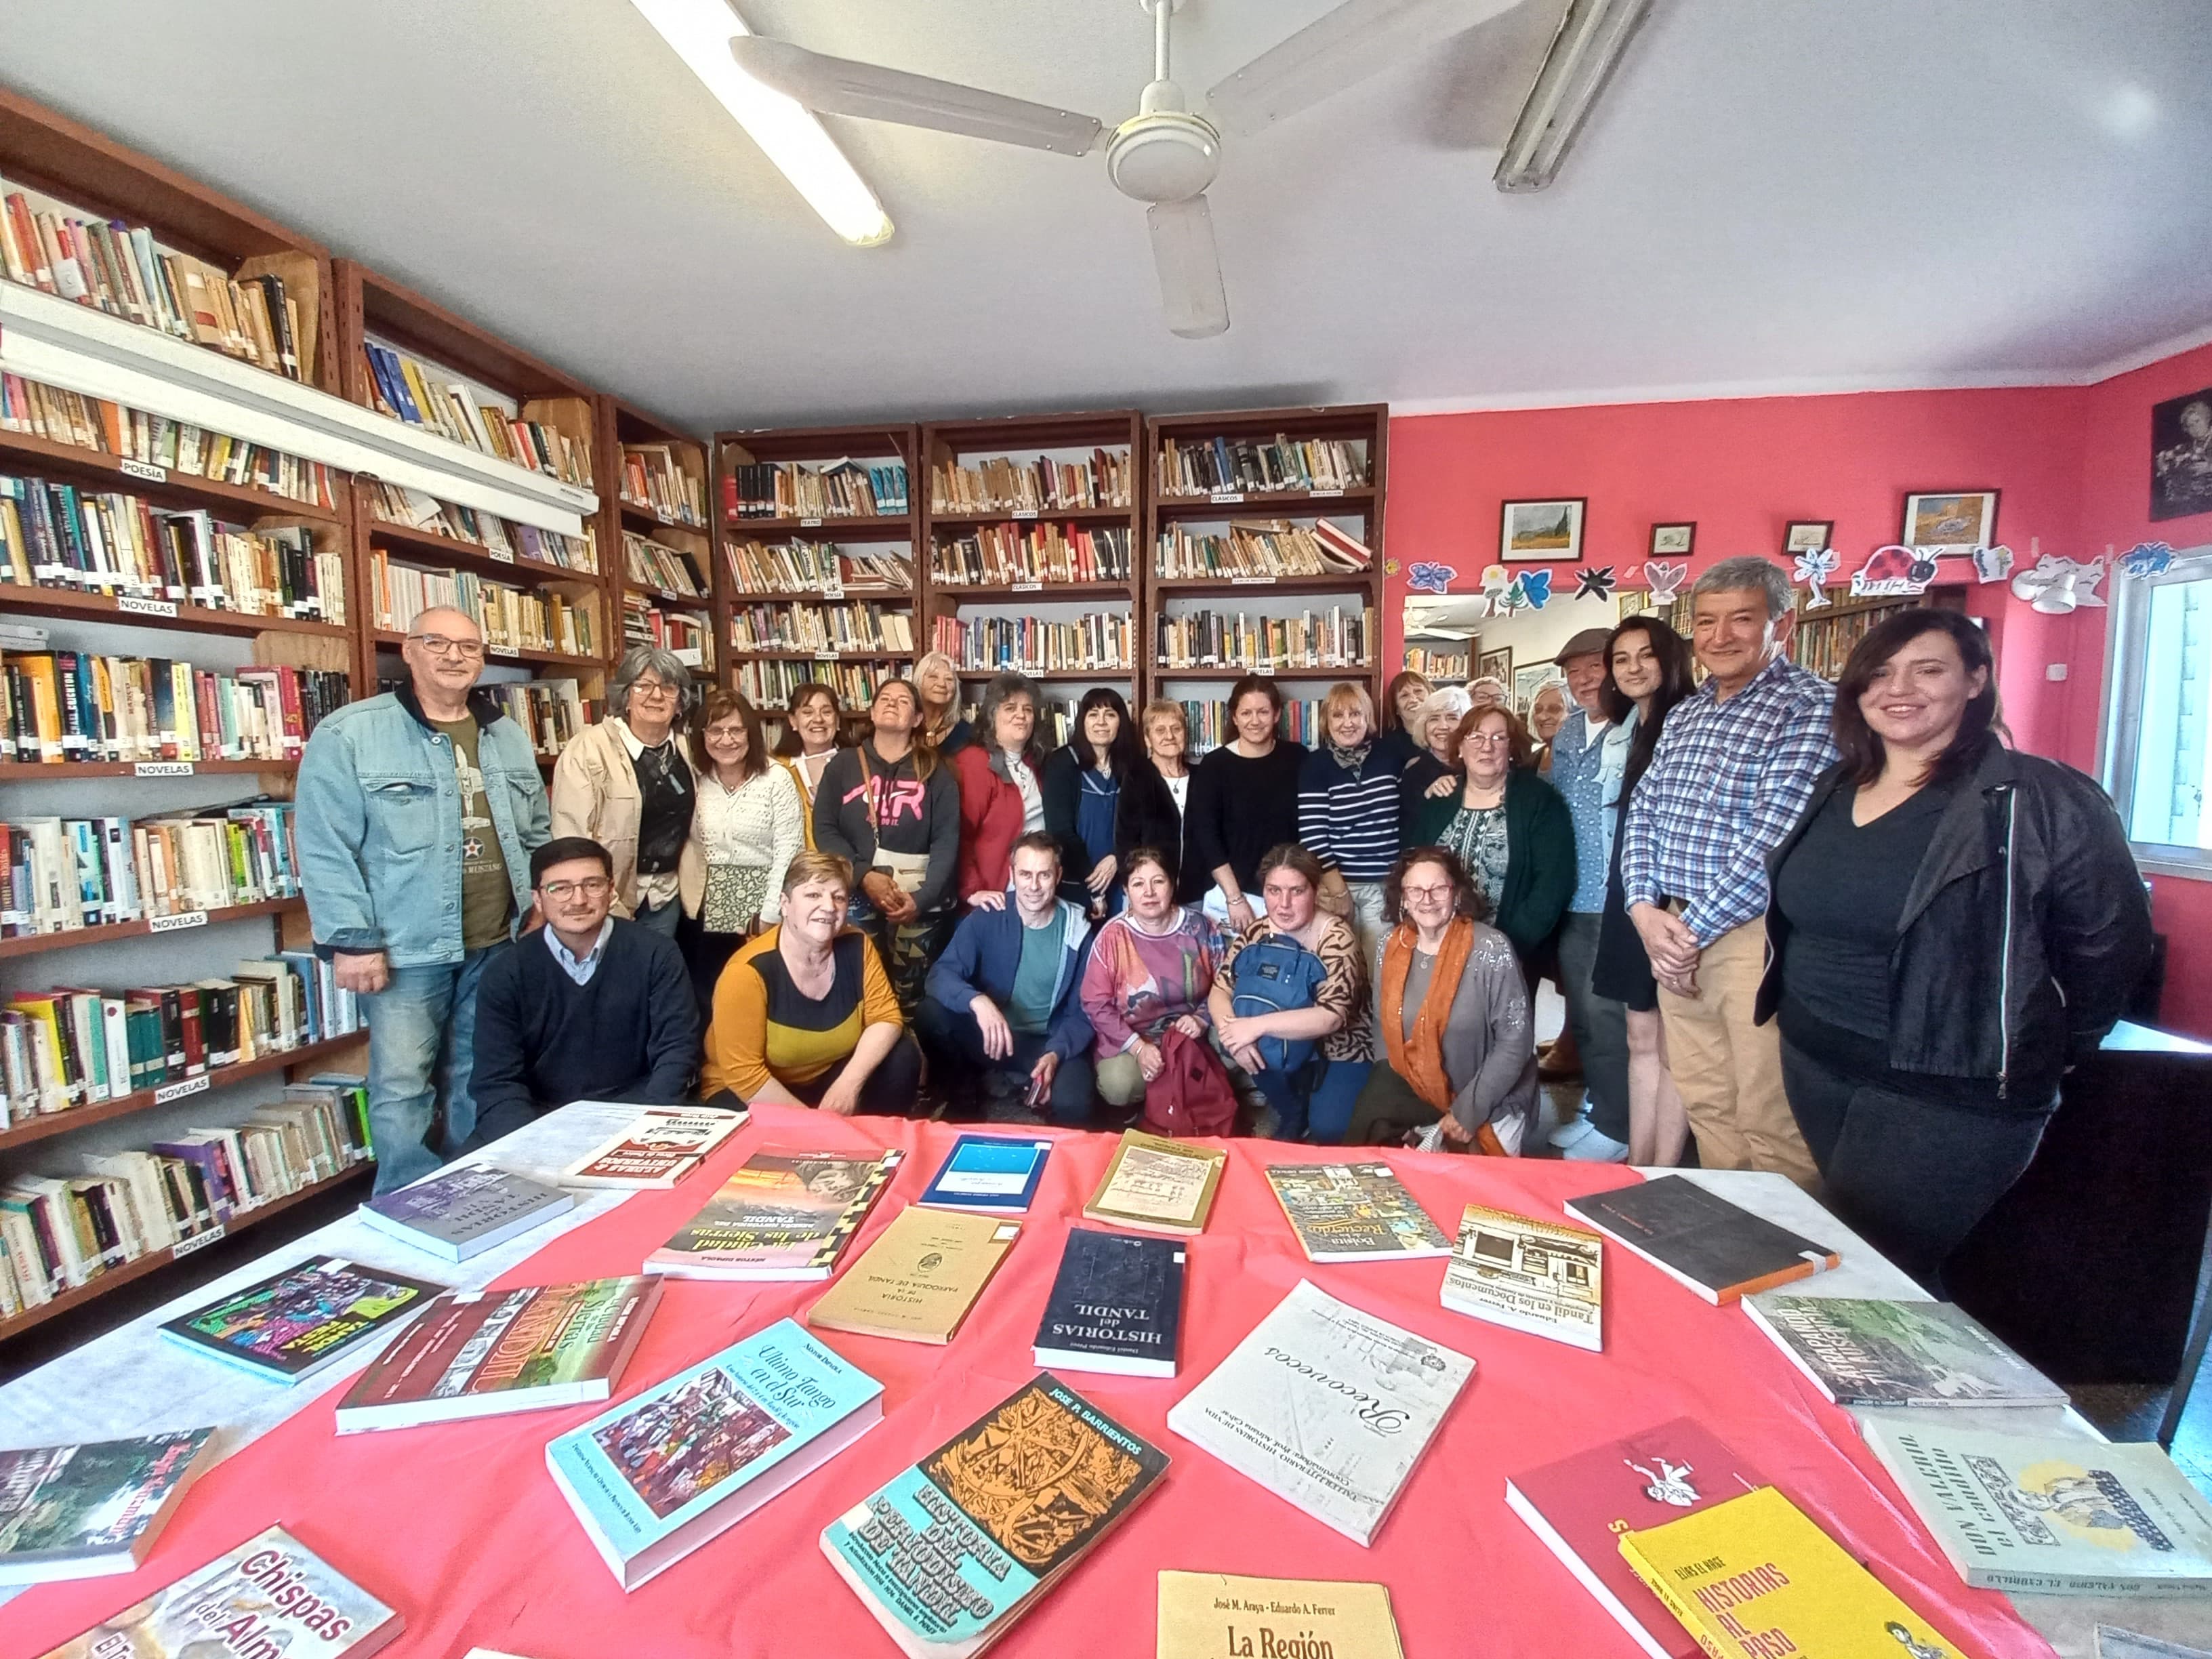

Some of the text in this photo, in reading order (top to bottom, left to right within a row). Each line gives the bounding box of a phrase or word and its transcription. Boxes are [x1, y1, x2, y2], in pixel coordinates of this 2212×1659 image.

[124, 463, 163, 478] POESÍA
[121, 600, 173, 614] NOVELAS
[138, 766, 190, 774] NOVELAS
[152, 914, 204, 928] NOVELAS
[157, 1078, 206, 1102] NOVELAS
[739, 1214, 796, 1223] TANDIL
[1304, 1225, 1385, 1234] Recuerdos
[174, 1227, 222, 1256] NOVELAS
[687, 1228, 760, 1241] Sierras
[690, 1239, 766, 1250] Ciudad
[793, 1231, 821, 1240] de
[1330, 1237, 1376, 1245] Bolsita
[879, 1293, 923, 1303] HISTORIA
[910, 1282, 960, 1292] PARROQUIA
[1448, 1277, 1515, 1304] Documentos
[1073, 1303, 1149, 1320] TANDIL
[1517, 1296, 1534, 1310] los
[1537, 1301, 1551, 1313] en
[1554, 1305, 1593, 1324] Tandil
[556, 1300, 606, 1349] Sierras
[585, 1305, 621, 1343] Ciudad
[1099, 1317, 1120, 1327] del
[1519, 1309, 1557, 1323] Eduardo
[465, 1284, 582, 1395] TANDIL
[1051, 1323, 1162, 1344] HISTORIAS
[1776, 1308, 1860, 1379] ATRAPANDO
[1797, 1306, 1899, 1384] TU AUSENCIA
[749, 1366, 806, 1412] en el Sur
[793, 1374, 838, 1414] Tango
[1261, 1345, 1412, 1438] Recovecos
[1048, 1387, 1143, 1454] JOSE P. BARRIENTOS
[1202, 1407, 1223, 1422] VIDA
[1219, 1419, 1235, 1430] DE
[1232, 1427, 1278, 1455] HISTORIAS
[1242, 1422, 1274, 1443] Adriana
[1271, 1440, 1292, 1454] Prof.
[1290, 1450, 1351, 1487] Coordinadora:
[1320, 1476, 1359, 1501] TALLER
[1925, 1448, 1996, 1521] caudillo
[908, 1484, 1018, 1582] HISTORIA
[1954, 1519, 1997, 1555] DON
[1986, 1530, 2015, 1547] el
[917, 1521, 973, 1570] DEL
[852, 1517, 969, 1628] DE TANDIL
[868, 1501, 997, 1622] PERIODISMO
[241, 1549, 352, 1641] Chispas
[1692, 1563, 1790, 1613] HISTORIAS
[194, 1602, 219, 1625] del
[1233, 1600, 1242, 1610] M.
[1244, 1600, 1264, 1614] Araya
[1271, 1601, 1301, 1614] Eduardo
[1303, 1603, 1311, 1614] A.
[1313, 1603, 1335, 1616] Ferrer
[1716, 1612, 1751, 1639] AL
[95, 1634, 121, 1654] El
[1228, 1625, 1334, 1659] La Región
[1739, 1628, 1797, 1659] PASO
